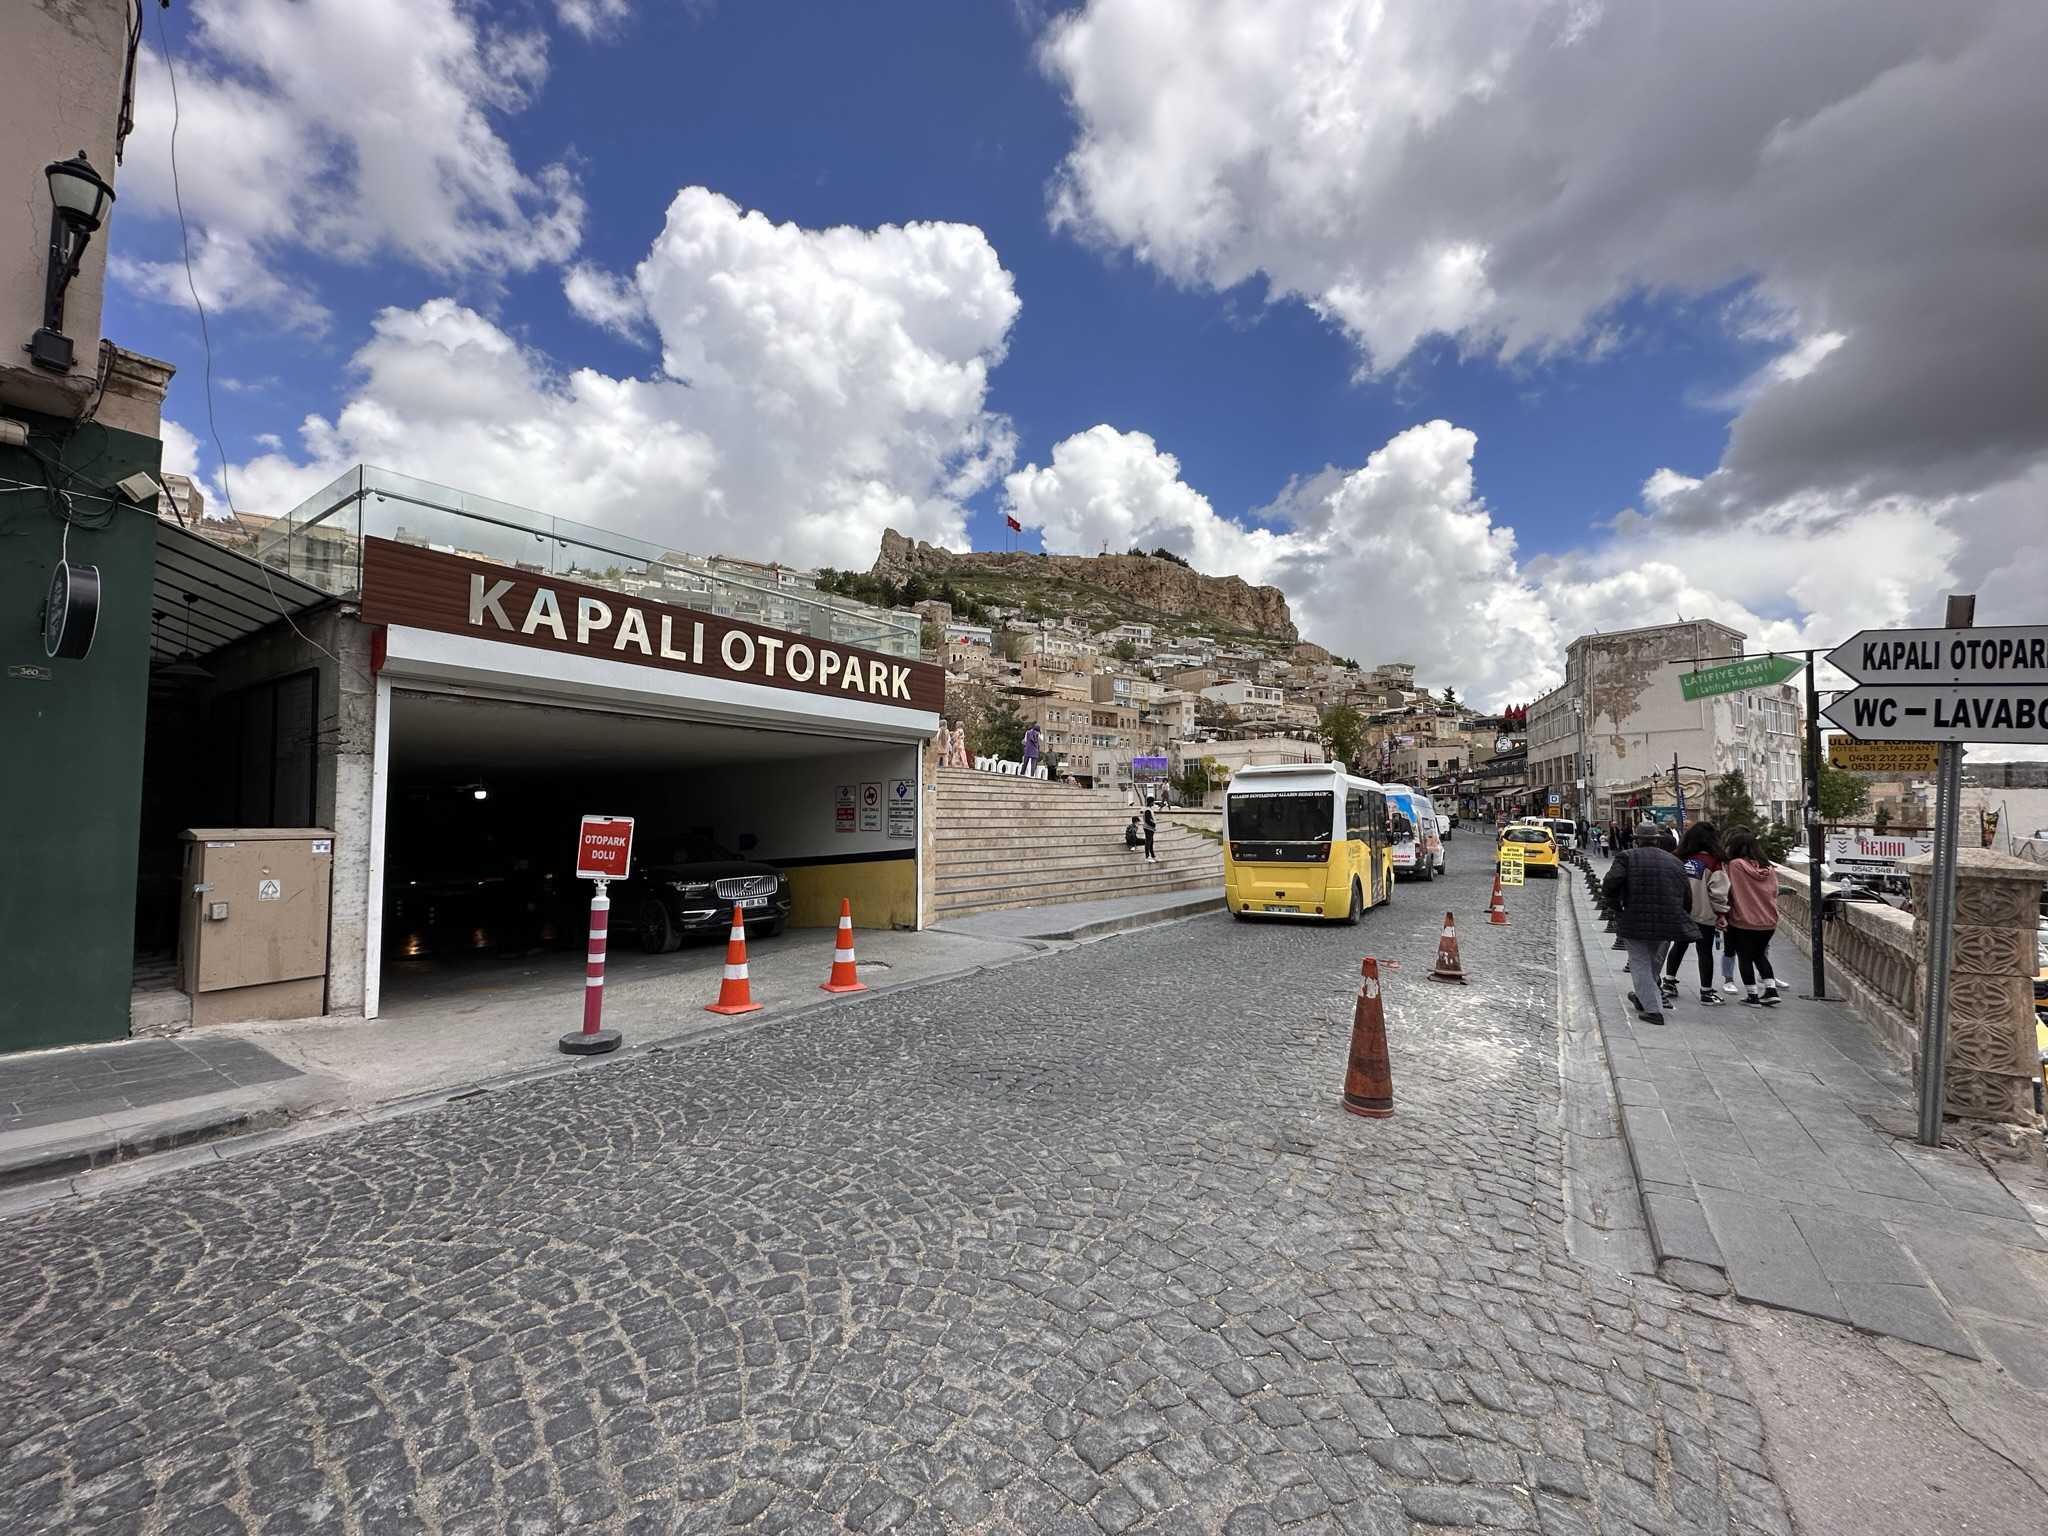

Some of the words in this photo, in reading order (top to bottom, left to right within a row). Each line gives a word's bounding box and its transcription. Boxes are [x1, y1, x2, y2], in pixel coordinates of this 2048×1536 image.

[468, 573, 704, 664] KAPALI
[721, 630, 912, 700] OTOPARK
[1862, 641, 1940, 670] KAPALI
[1951, 638, 2048, 670] OTOPAR
[1853, 698, 1897, 727] WC
[1848, 754, 1877, 762] 0482
[1879, 754, 1897, 762] 212
[1899, 754, 1914, 762] 22
[1916, 754, 1930, 762] 23
[1851, 763, 1876, 771] 0531
[1898, 763, 1911, 771] 57
[585, 835, 626, 847] OTOPARK
[592, 850, 616, 860] DOLU
